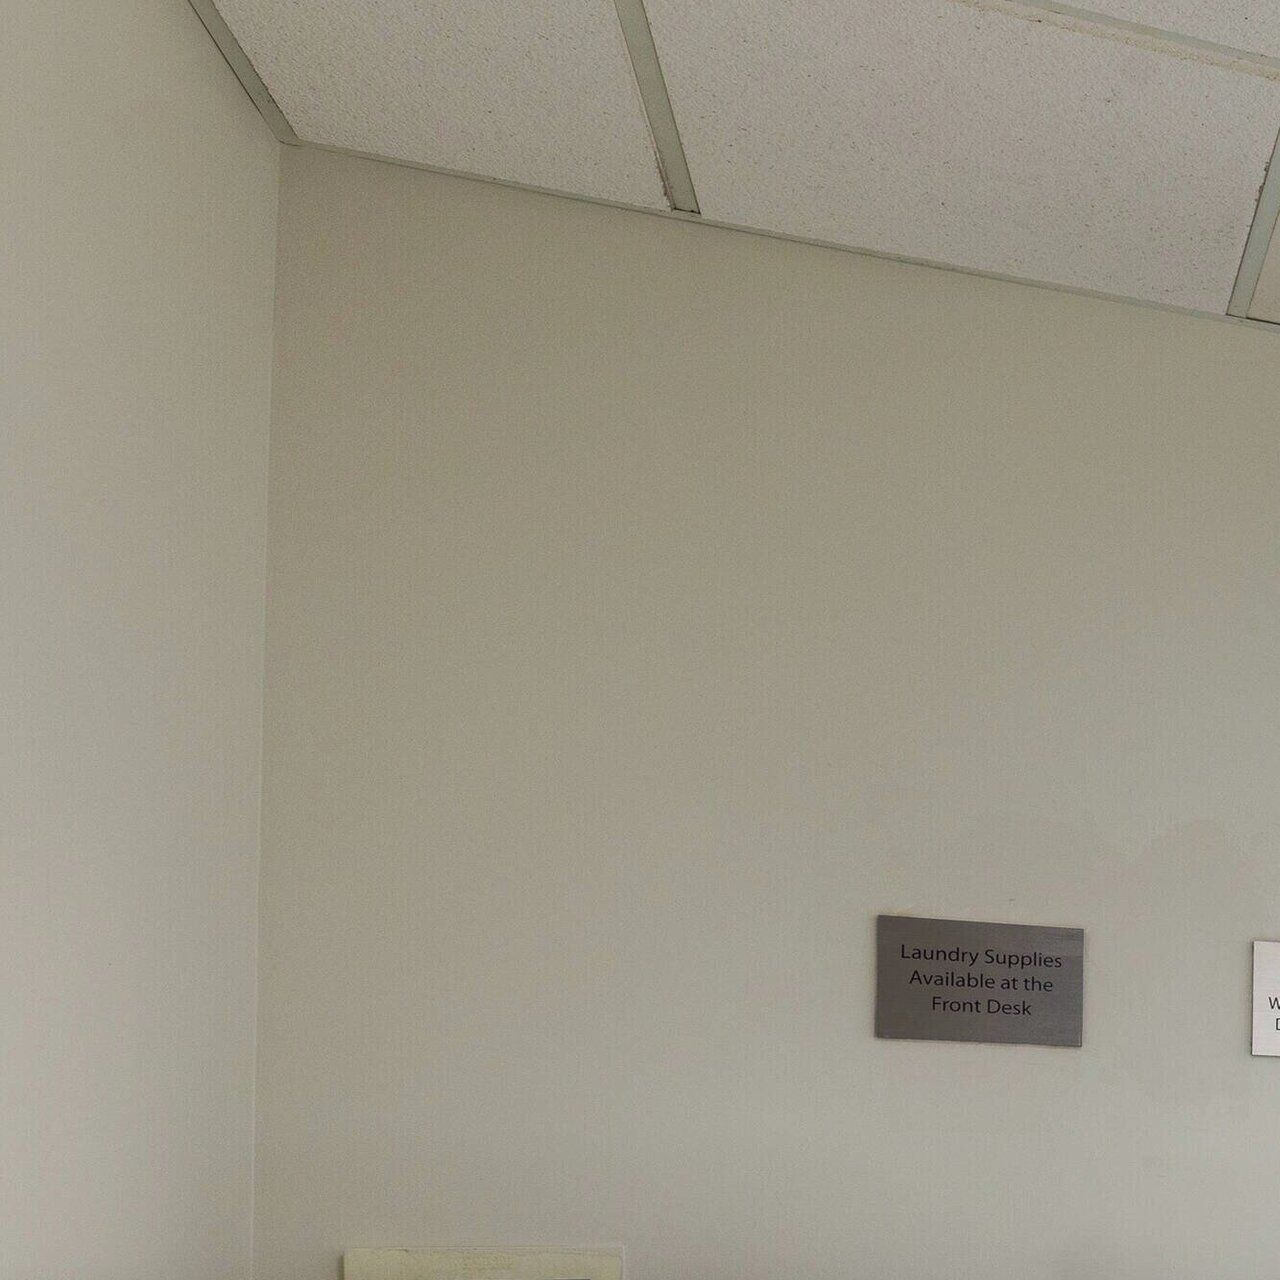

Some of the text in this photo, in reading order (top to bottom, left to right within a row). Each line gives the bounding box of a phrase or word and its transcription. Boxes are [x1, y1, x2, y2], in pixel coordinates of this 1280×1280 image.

[901, 944, 1062, 969] Laundry Supplies
[909, 970, 1053, 991] Available at the
[932, 997, 1031, 1015] Front Desk
